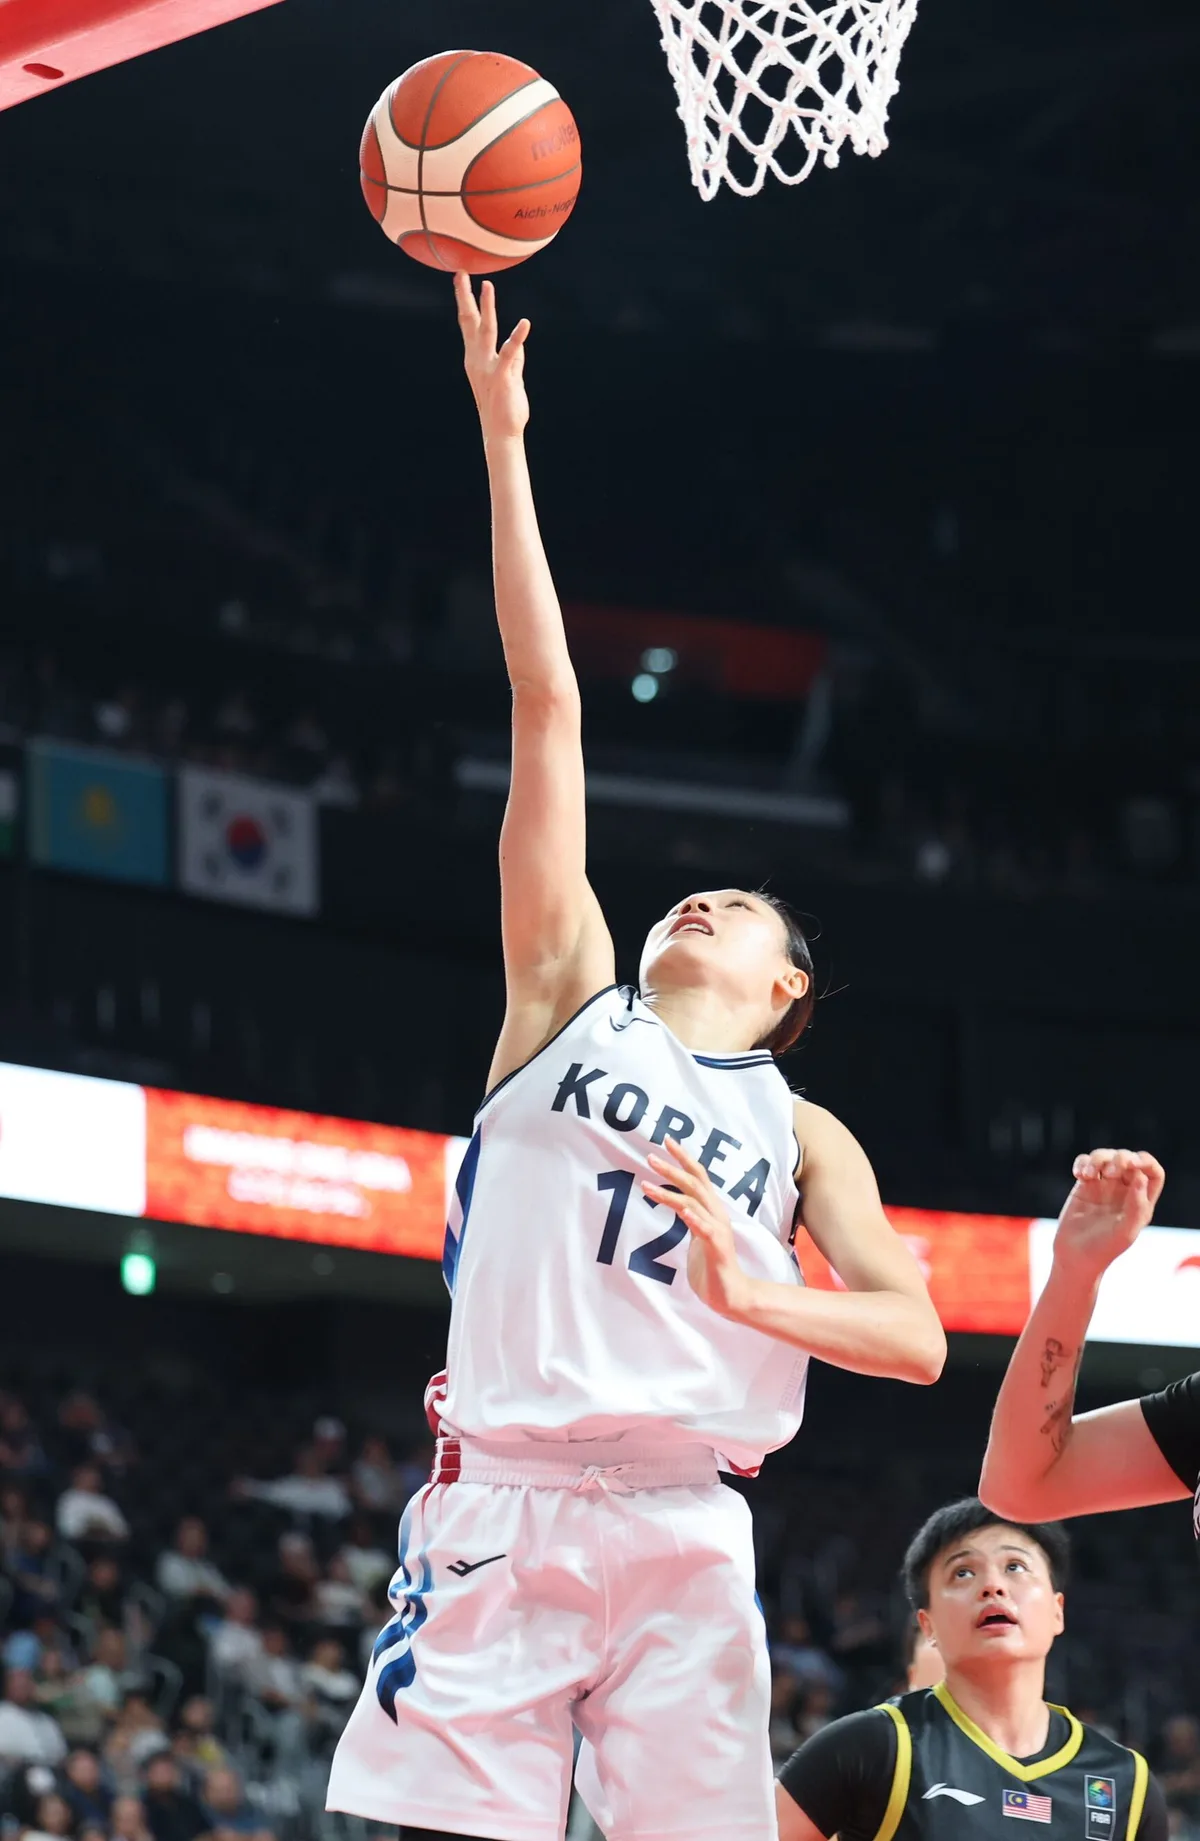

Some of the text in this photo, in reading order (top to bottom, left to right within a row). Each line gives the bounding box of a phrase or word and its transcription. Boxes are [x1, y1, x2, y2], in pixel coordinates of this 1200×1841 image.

[532, 122, 577, 160] molte
[551, 1063, 772, 1217] KOREA
[596, 1169, 689, 1286] 12
